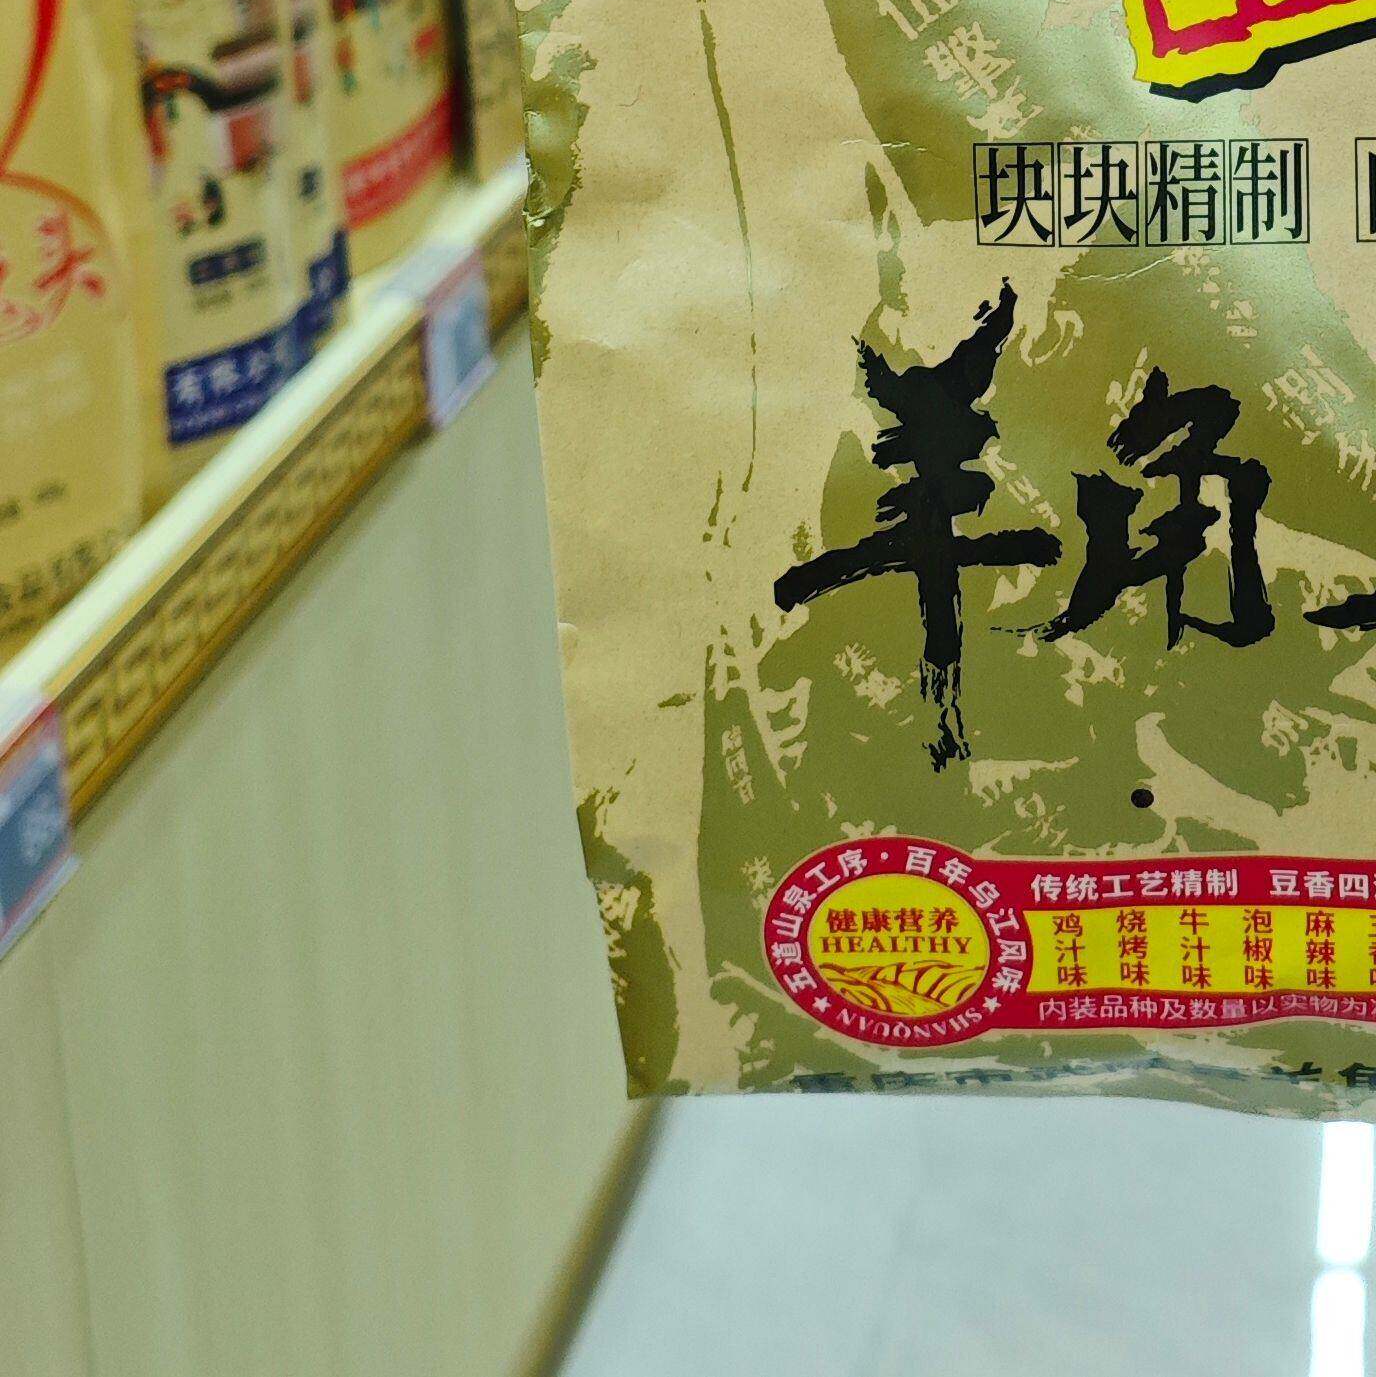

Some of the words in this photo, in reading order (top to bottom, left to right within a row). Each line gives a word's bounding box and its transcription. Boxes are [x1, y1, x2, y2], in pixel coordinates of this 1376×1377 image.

[974, 141, 1310, 246] 块块精制
[825, 907, 960, 934] 健康营养
[1030, 868, 1239, 903] 传统工艺精制
[820, 935, 973, 955] HEALTHY
[1052, 913, 1087, 988] 鸡汁味
[1116, 909, 1150, 988] 烧烤味
[1178, 909, 1212, 991] 牛汁味
[1242, 909, 1274, 991] 泡椒味
[1305, 911, 1337, 991] 麻辣味
